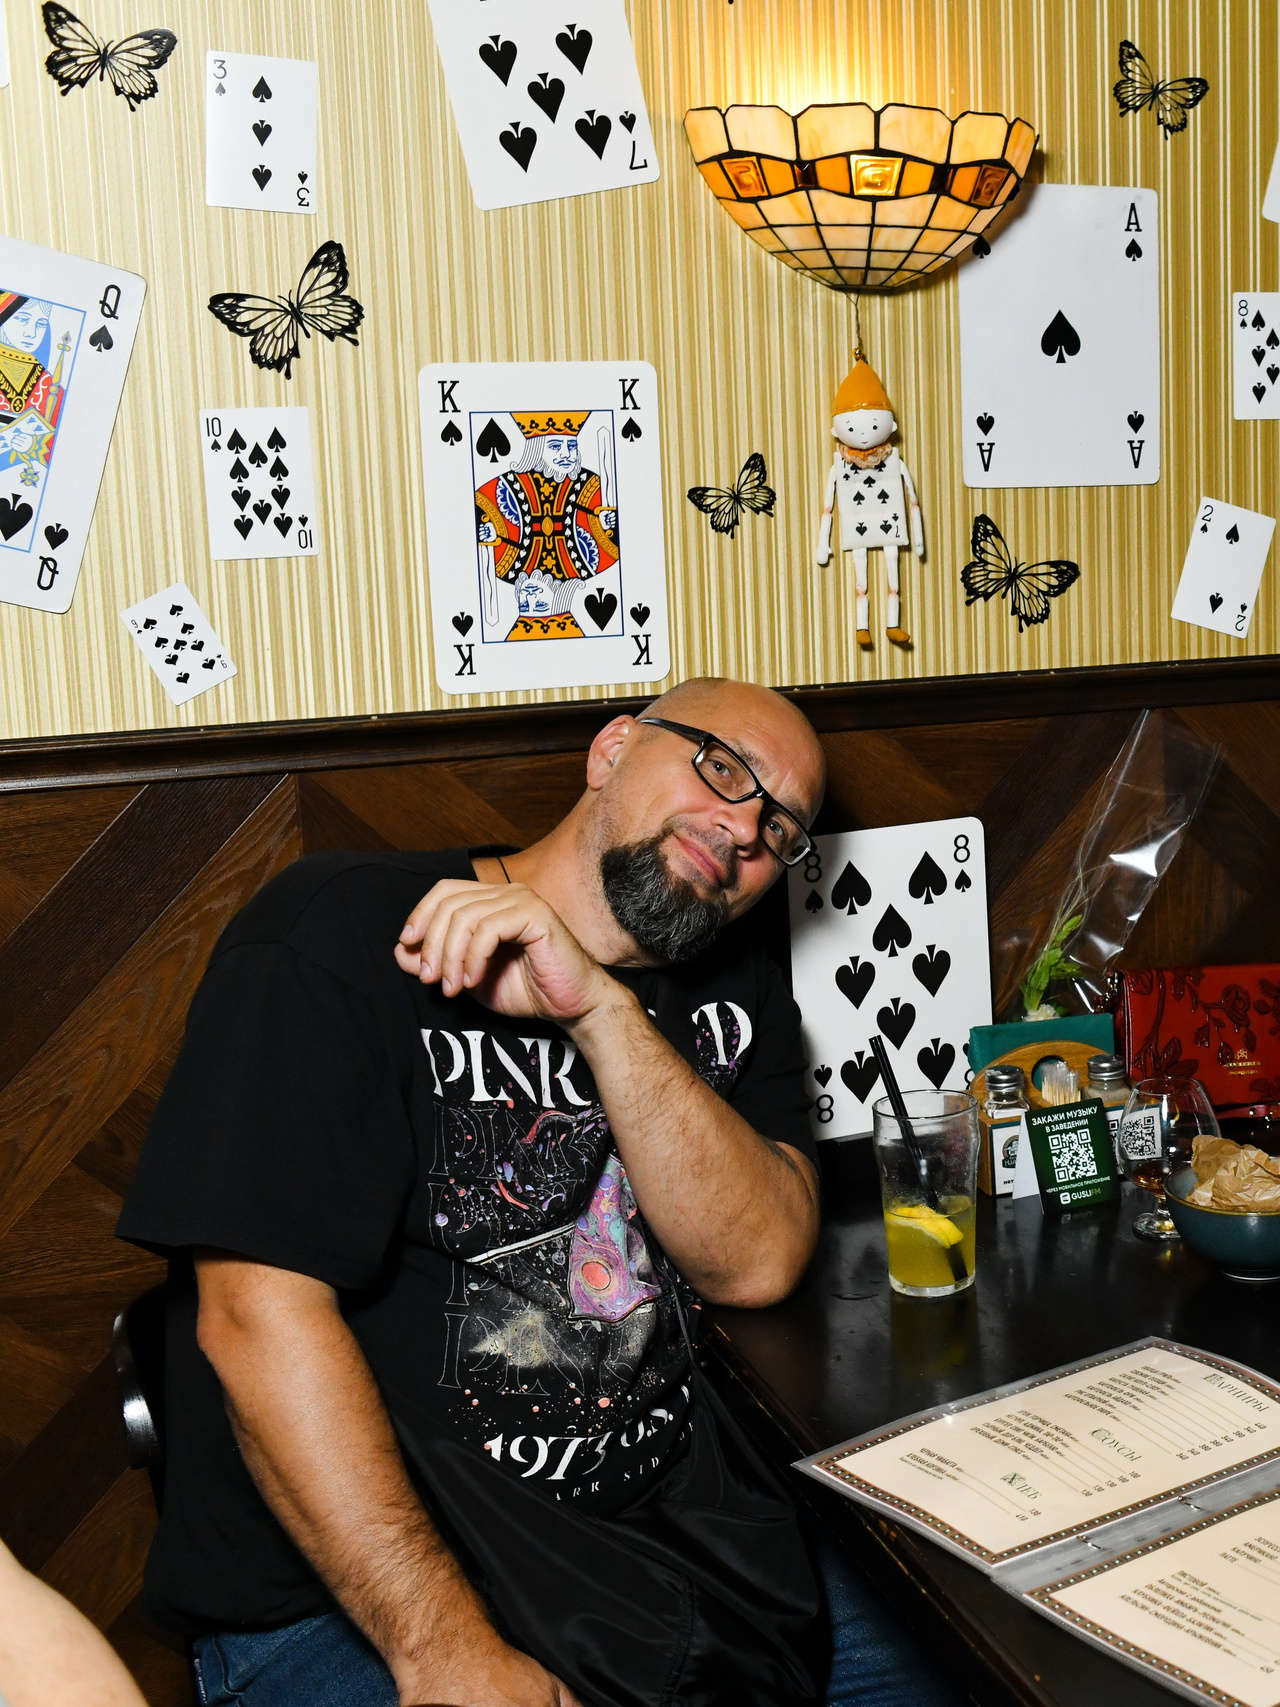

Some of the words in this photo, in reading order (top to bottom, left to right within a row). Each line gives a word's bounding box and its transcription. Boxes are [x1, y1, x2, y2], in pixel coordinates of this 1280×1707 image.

[214, 60, 227, 79] 3
[629, 141, 648, 170] 7
[297, 188, 309, 206] 3
[1125, 203, 1142, 232] A
[99, 285, 121, 320] Q
[1238, 300, 1248, 316] 8
[438, 381, 461, 413] K
[619, 379, 640, 410] K
[206, 417, 221, 437] 10
[977, 443, 995, 472] A
[1127, 440, 1145, 468] A
[1202, 505, 1213, 522] 2
[298, 530, 312, 549] 10
[37, 556, 59, 590] Q
[1235, 615, 1246, 631] 2
[631, 634, 652, 665] K
[454, 644, 476, 676] K
[954, 834, 970, 863] 8
[804, 853, 823, 883] 8
[815, 1094, 834, 1124] 8
[1031, 1112, 1065, 1126] ЗАКАЖИ
[1066, 1106, 1098, 1119] МУЗЫКУ
[1045, 1125, 1051, 1133] В
[1051, 1118, 1089, 1132] ЗАВЕДЕНИИ
[1046, 1185, 1059, 1193] ЧЕРЕЗ
[1058, 1181, 1084, 1191] МОБИЛЬНОЕ
[1083, 1176, 1111, 1186] ПРИЛОЖЕНИЕ
[1243, 1425, 1256, 1433] 340
[1087, 1428, 1141, 1461] СОУСЫ
[484, 1431, 614, 1480] 1973
[1175, 1452, 1189, 1460] 340
[1104, 1479, 1117, 1487] 130
[1116, 1475, 1129, 1483] 100
[1128, 1470, 1141, 1478] 100
[1000, 1472, 1041, 1499] ХЛЕБ
[1092, 1484, 1105, 1492] 130
[1028, 1508, 1041, 1516] 130
[1220, 1552, 1238, 1563] ЛАТТЕ
[1231, 1546, 1261, 1563] КАПУЧИНО
[1243, 1542, 1277, 1560] АМЕРИКАНО
[1178, 1570, 1207, 1587] ЛИСТОВОЙ
